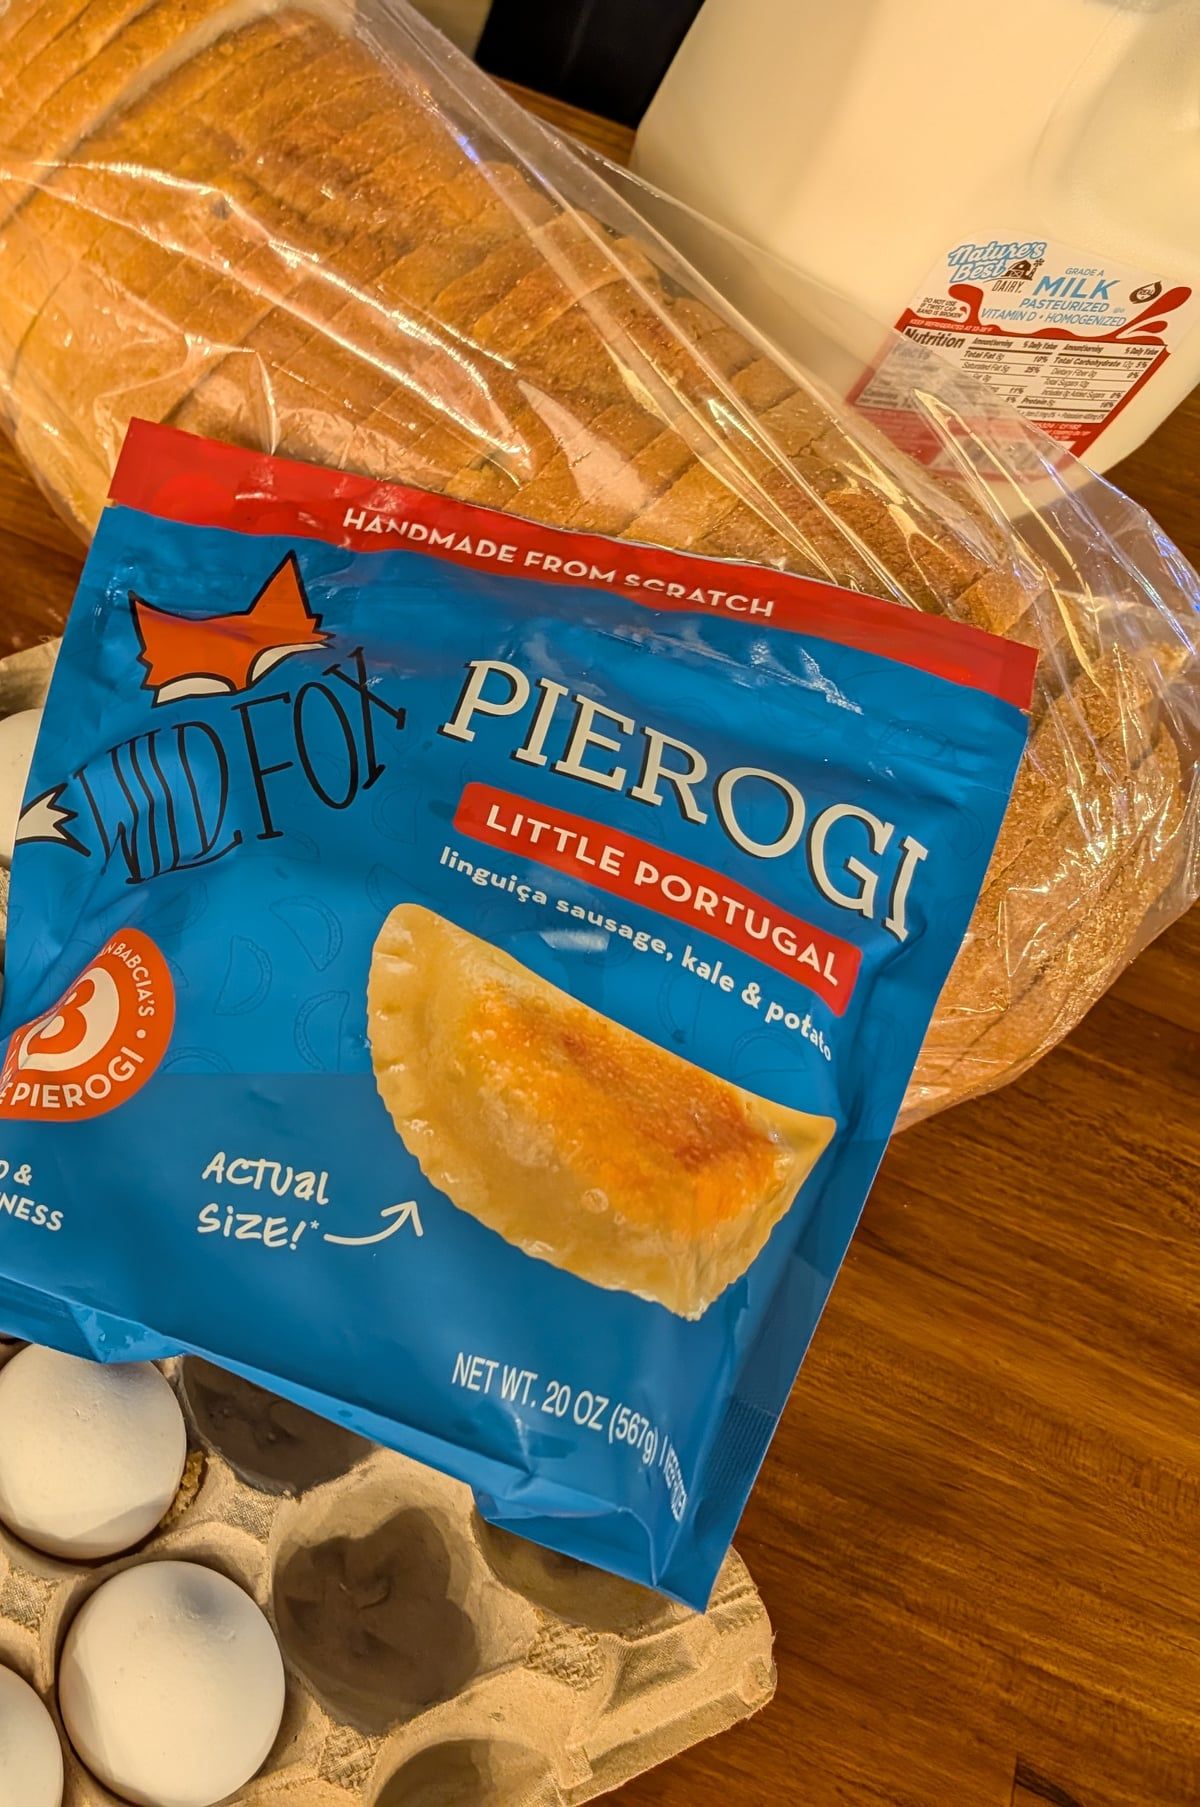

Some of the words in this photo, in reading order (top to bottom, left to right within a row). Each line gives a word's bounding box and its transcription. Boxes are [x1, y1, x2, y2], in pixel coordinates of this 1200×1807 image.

[948, 241, 1047, 266] Nature's
[950, 260, 1007, 283] Best
[1065, 268, 1096, 277] GRADE
[1032, 276, 1120, 300] MILK
[1019, 298, 1110, 313] PASTEURIZED
[981, 308, 1026, 321] VITAMIN
[1026, 313, 1037, 322] D
[1044, 313, 1128, 328] HOMOGENIZED
[904, 328, 966, 348] Nutrition
[963, 350, 983, 358] Total
[983, 351, 996, 360] Fat
[1053, 356, 1073, 364] Total
[1073, 357, 1121, 367] Carbohydrate
[343, 508, 516, 564] HANDMADE
[524, 551, 615, 584] FROM
[623, 573, 775, 618] SCRATCH
[70, 721, 242, 884] WILD
[232, 647, 407, 840] FOX
[438, 660, 930, 943] PIEROGI
[486, 804, 626, 877] LITTLE
[634, 861, 839, 987] PORTUGAL
[440, 846, 548, 906] linguiça
[556, 898, 676, 962] sausage,
[681, 945, 735, 994] kale
[741, 982, 761, 1009] &
[765, 1001, 831, 1061] potato
[112, 942, 156, 1017] BABCIA'S
[9, 1046, 145, 1108] PIEROGI
[13, 1164, 32, 1186] &
[452, 1352, 499, 1394] NET
[500, 1365, 538, 1408] WT.
[541, 1380, 571, 1417] 20
[573, 1390, 610, 1431] OZ
[608, 1403, 658, 1467] (567g)
